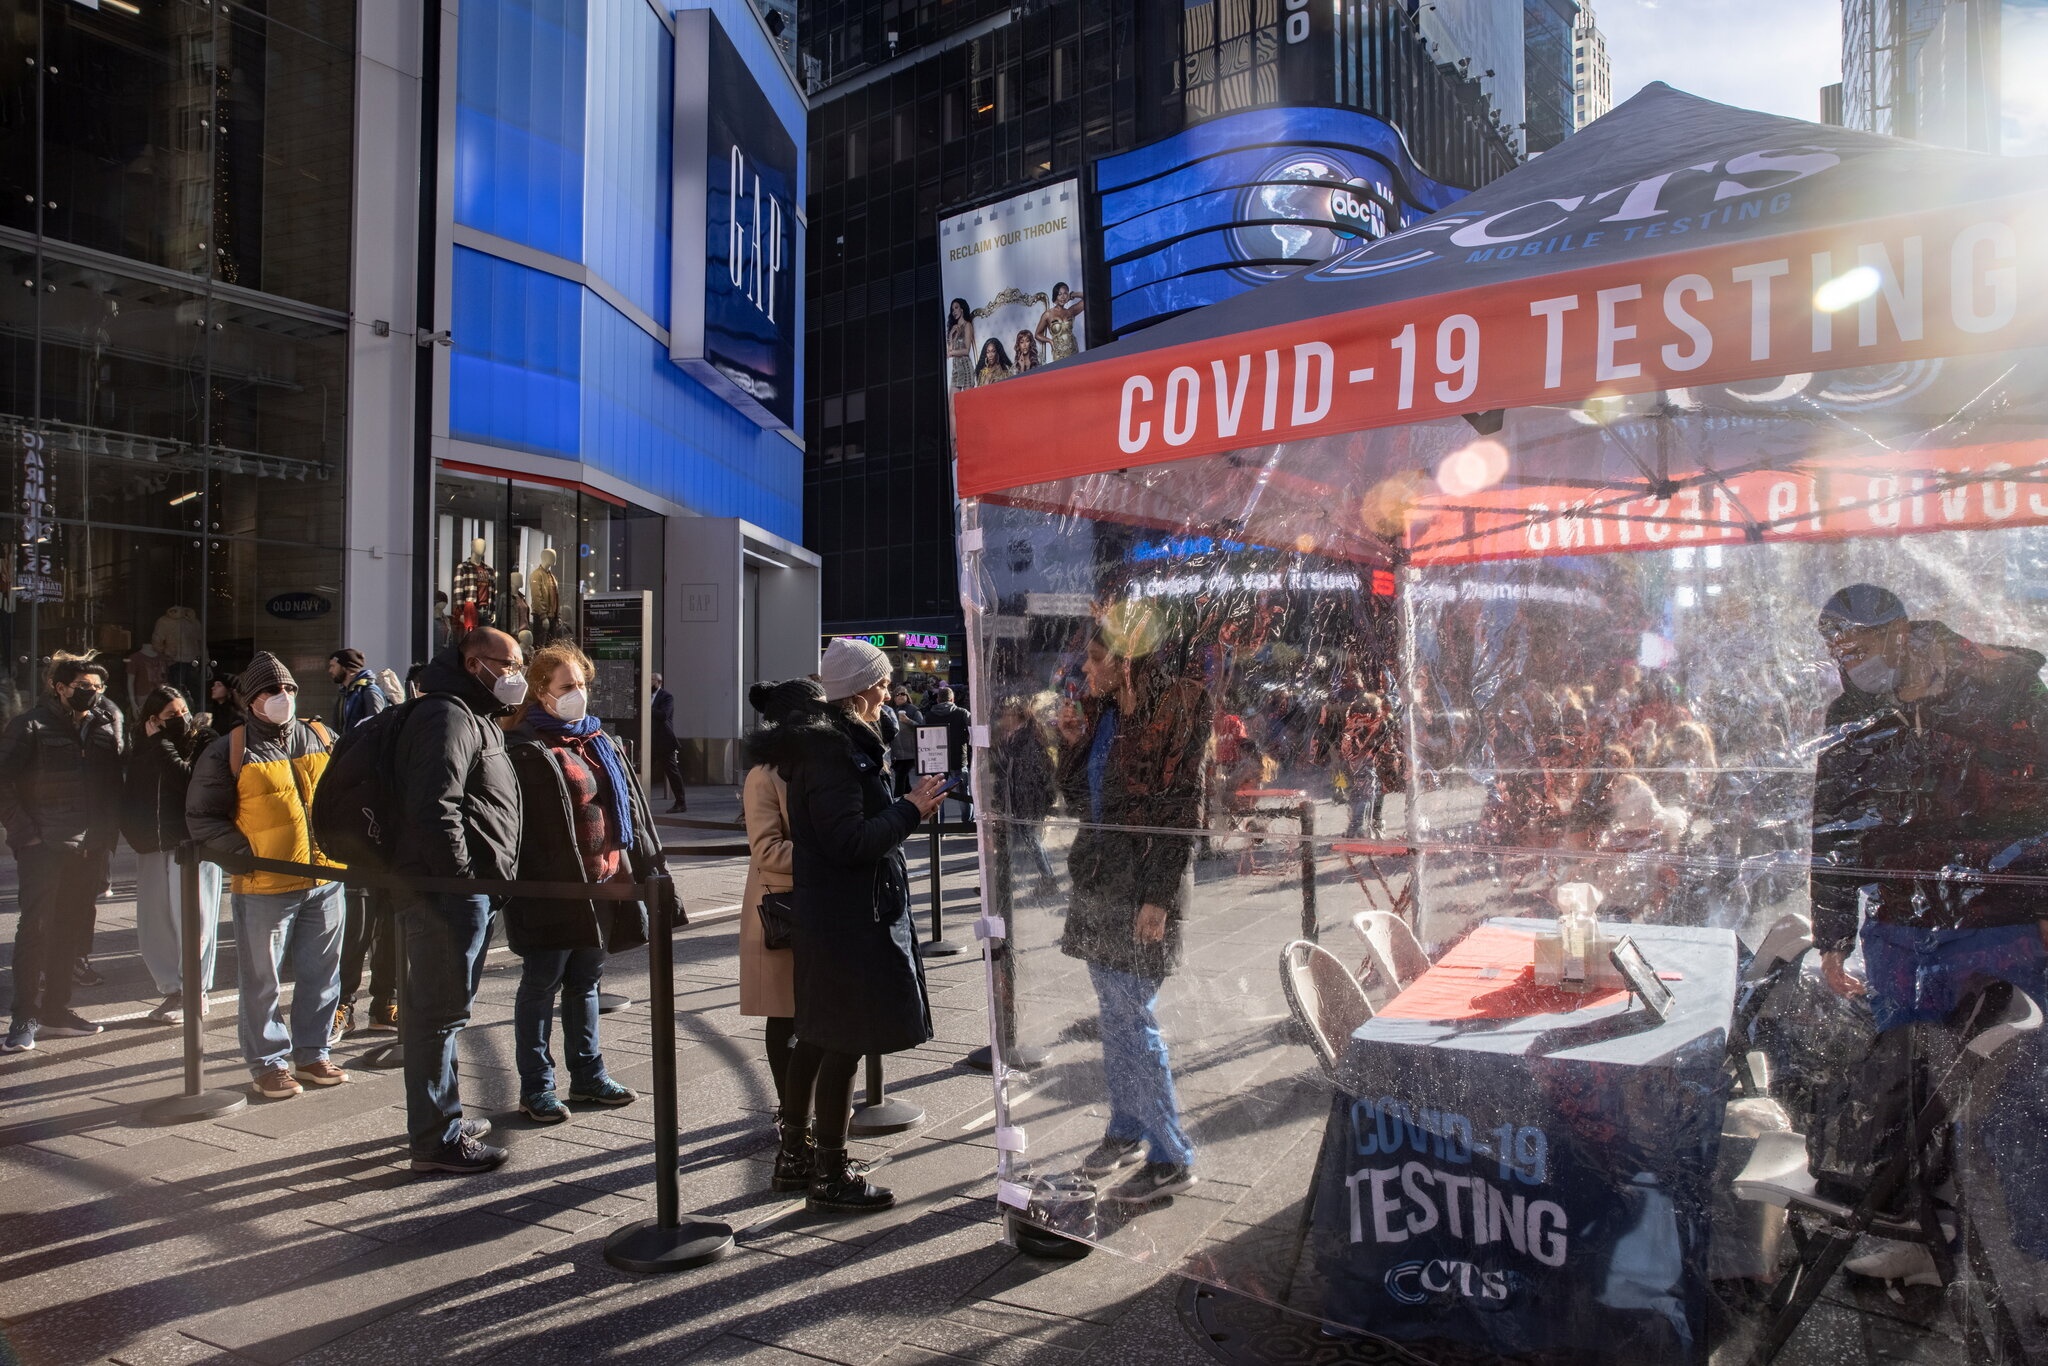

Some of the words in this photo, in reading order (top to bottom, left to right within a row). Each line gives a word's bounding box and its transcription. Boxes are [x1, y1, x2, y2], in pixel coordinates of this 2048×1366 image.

[1329, 183, 1370, 224] abc
[1449, 144, 1841, 250] CTS
[1465, 229, 1602, 264] MOBILE
[1622, 191, 1794, 242] TESTING
[728, 143, 781, 325] GAP
[949, 240, 993, 264] RECLAIM
[993, 232, 1023, 255] YOUR
[1023, 215, 1068, 246] THRONE
[1117, 313, 1481, 457] COVID-19
[1530, 222, 2018, 391] TESTING
[272, 600, 292, 613] OLD
[293, 600, 321, 612] NAVY
[689, 594, 711, 611] GAP
[906, 633, 939, 649] SALAD
[1352, 1098, 1548, 1186] COVID-19
[1346, 1161, 1568, 1268] TESTING
[1419, 1258, 1508, 1301] CTS
